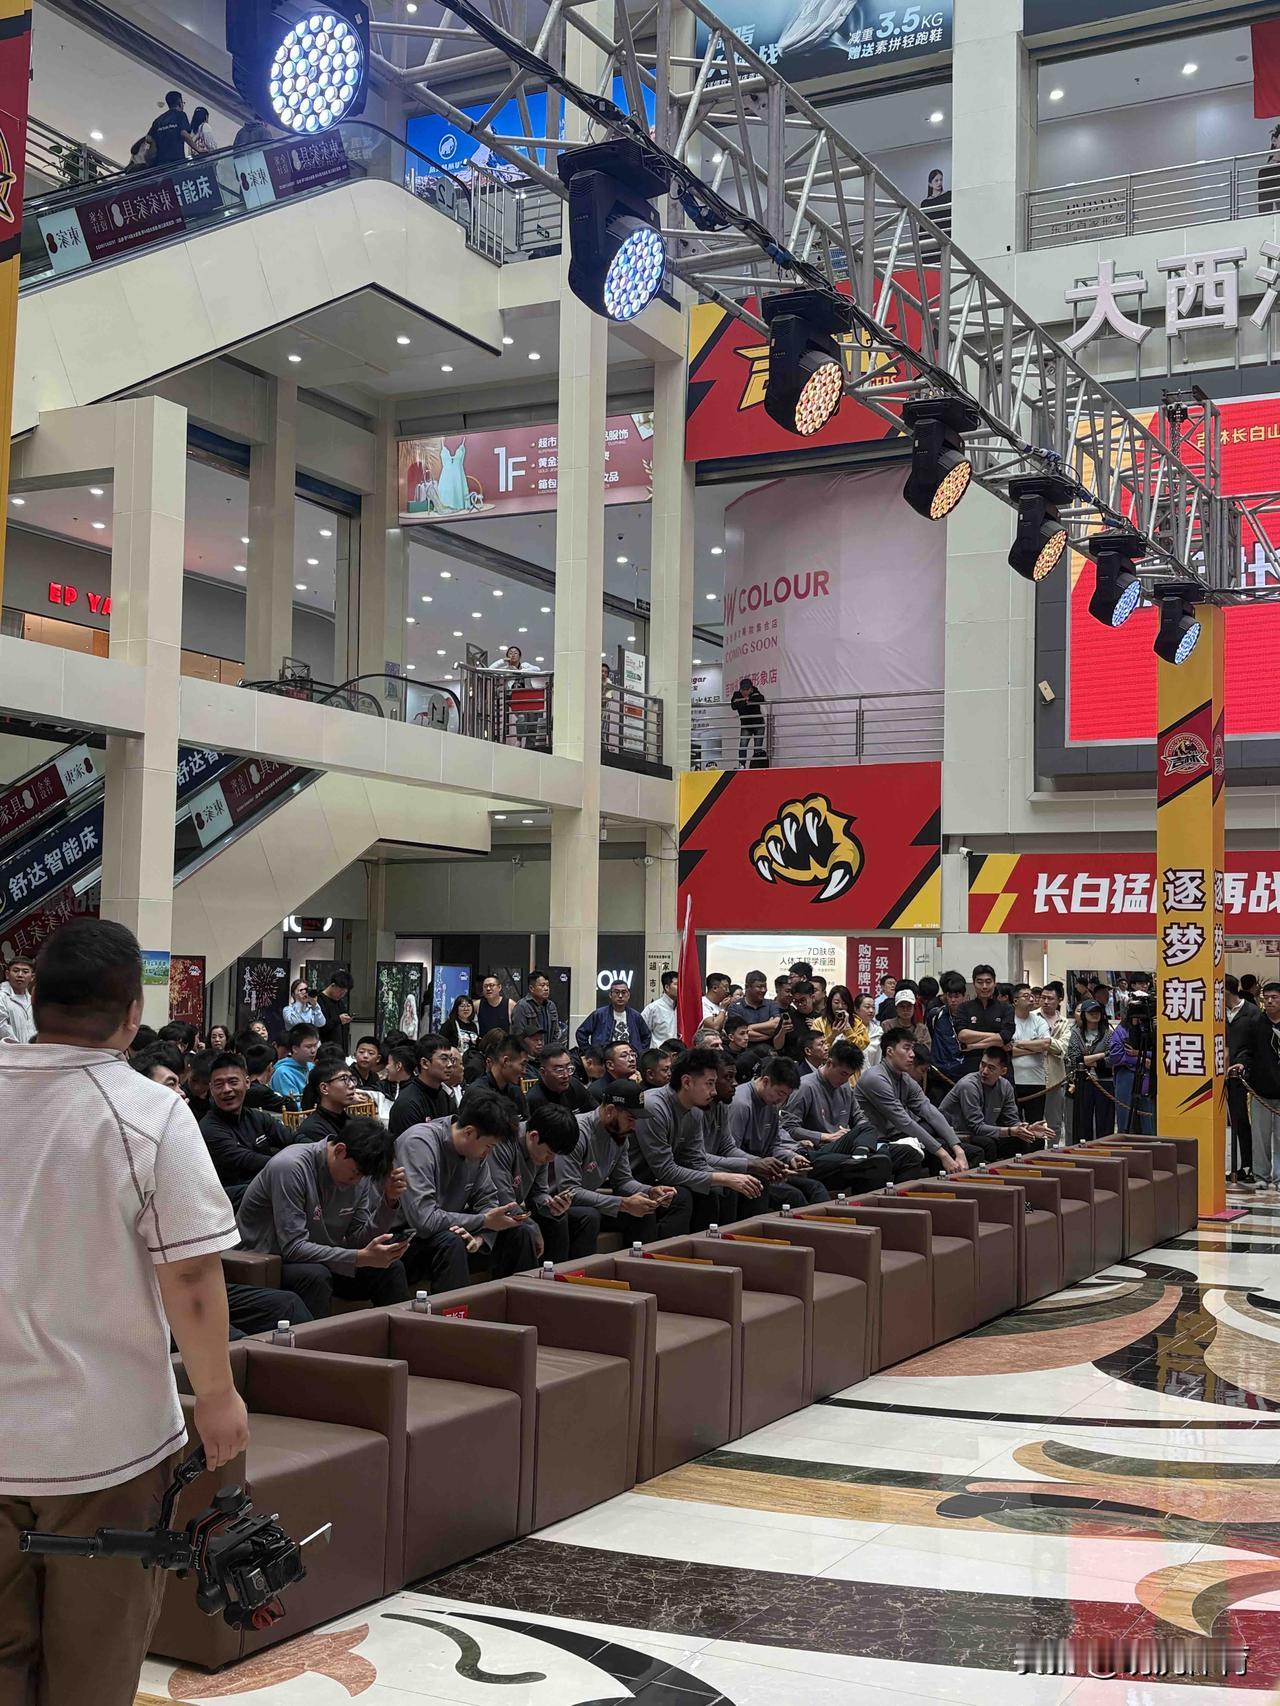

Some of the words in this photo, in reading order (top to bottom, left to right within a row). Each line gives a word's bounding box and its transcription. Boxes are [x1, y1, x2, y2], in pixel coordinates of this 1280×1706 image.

[537, 437, 557, 449] 超市
[494, 446, 527, 492] 1F
[537, 456, 558, 469] 黄金
[49, 582, 78, 606] EP
[738, 570, 829, 615] COLOUR
[749, 636, 778, 654] SOON
[691, 676, 706, 685] gar
[176, 750, 225, 787] 舒达智
[8, 825, 99, 902] 舒达智能床
[1033, 872, 1157, 914] 长白猛
[596, 969, 634, 991] OW
[1163, 867, 1207, 1077] 逐梦新程
